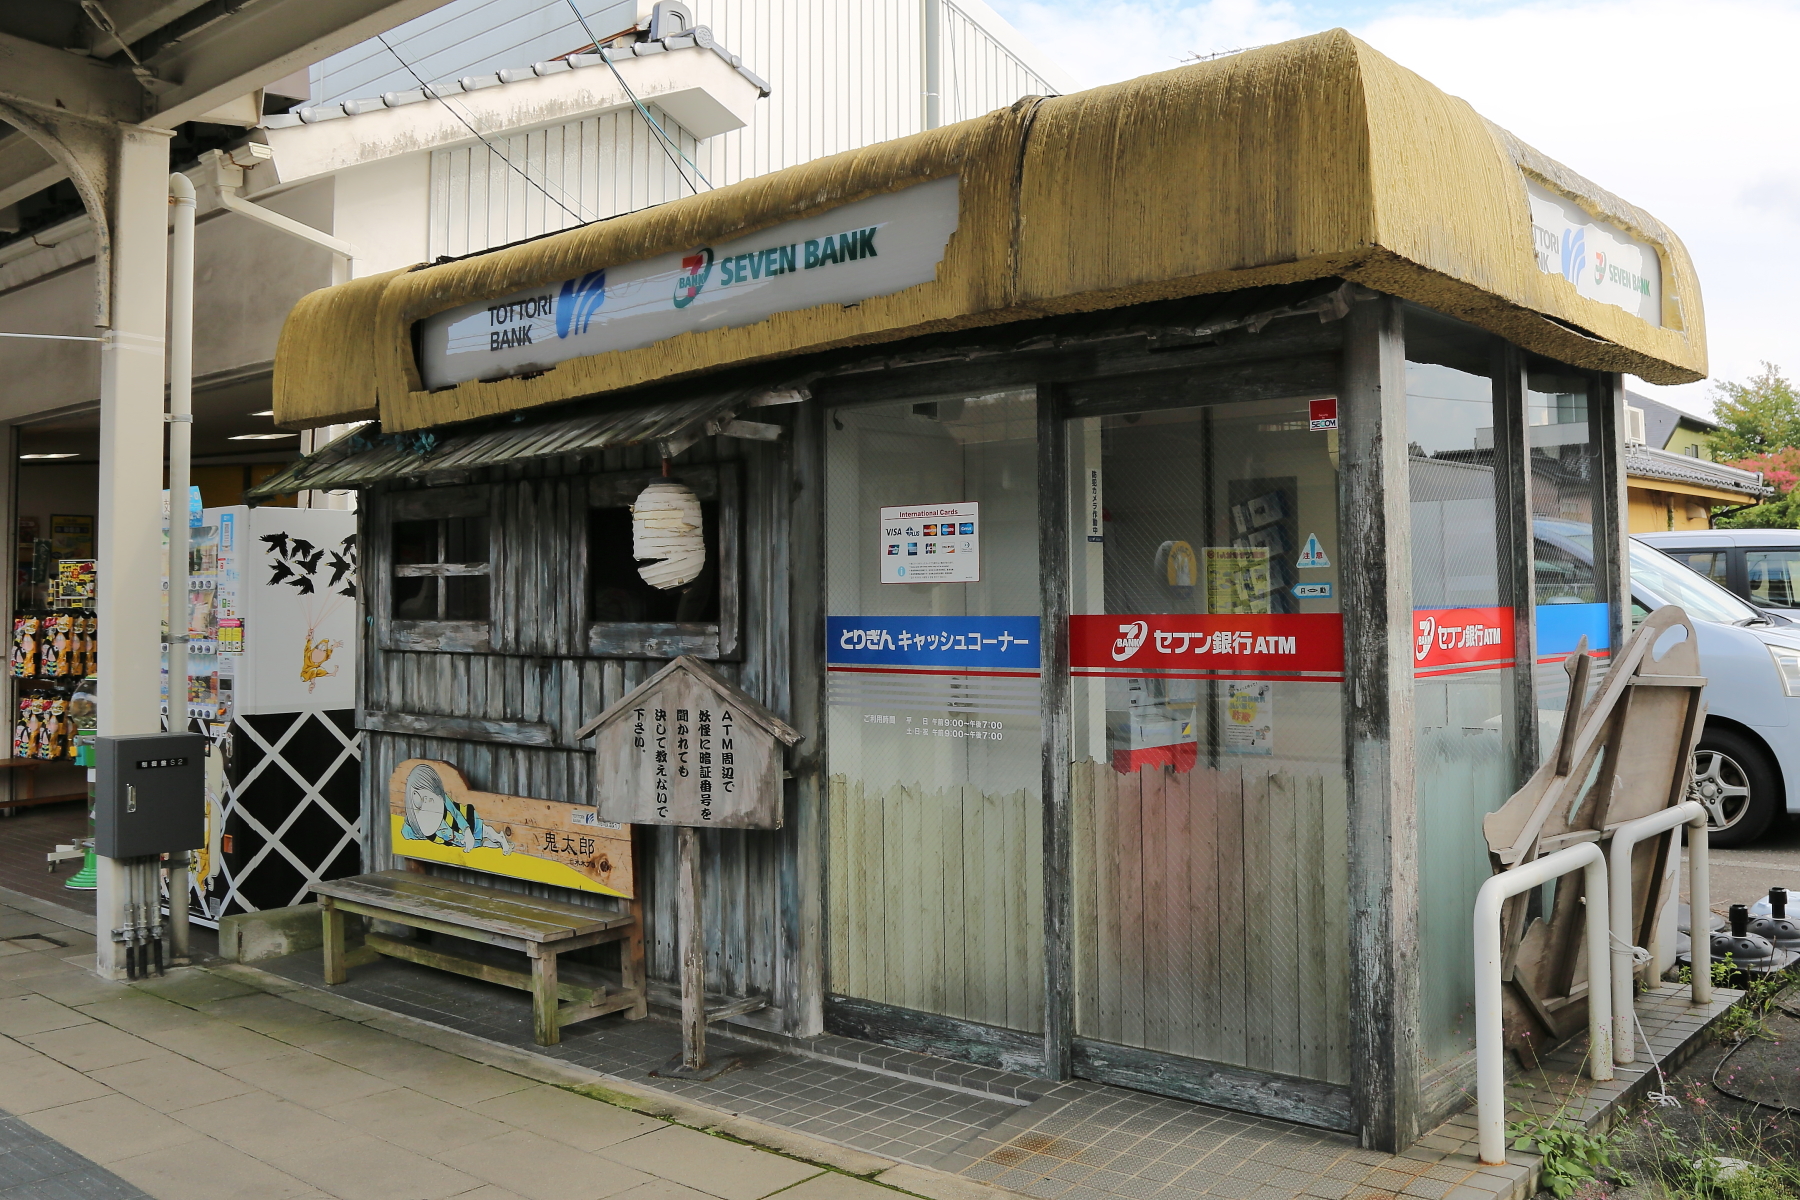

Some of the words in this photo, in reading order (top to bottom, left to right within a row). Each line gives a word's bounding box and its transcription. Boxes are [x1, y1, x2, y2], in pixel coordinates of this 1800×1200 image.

[720, 243, 796, 286] SEVEN
[804, 227, 878, 270] BANK
[679, 272, 706, 289] BANK
[1609, 264, 1632, 290] SEVEN
[1632, 273, 1651, 297] BANK
[488, 294, 553, 326] TOTTORI
[490, 324, 533, 351] BANK
[1311, 420, 1336, 429] SECOM
[899, 510, 939, 518] International
[939, 508, 959, 516] Cards
[886, 528, 902, 537] VISA
[840, 629, 896, 651] とりぎん
[898, 629, 1029, 652] キャッシュコーナー
[1116, 638, 1141, 648] BANK
[863, 714, 896, 725] ご利用時間
[676, 709, 689, 778] 聞かれても
[721, 710, 735, 793] ATM周辺で
[655, 708, 668, 818] 決して教えないで
[698, 709, 712, 820] 妖怪に暗証番号を
[543, 831, 595, 859] 鬼太郎
